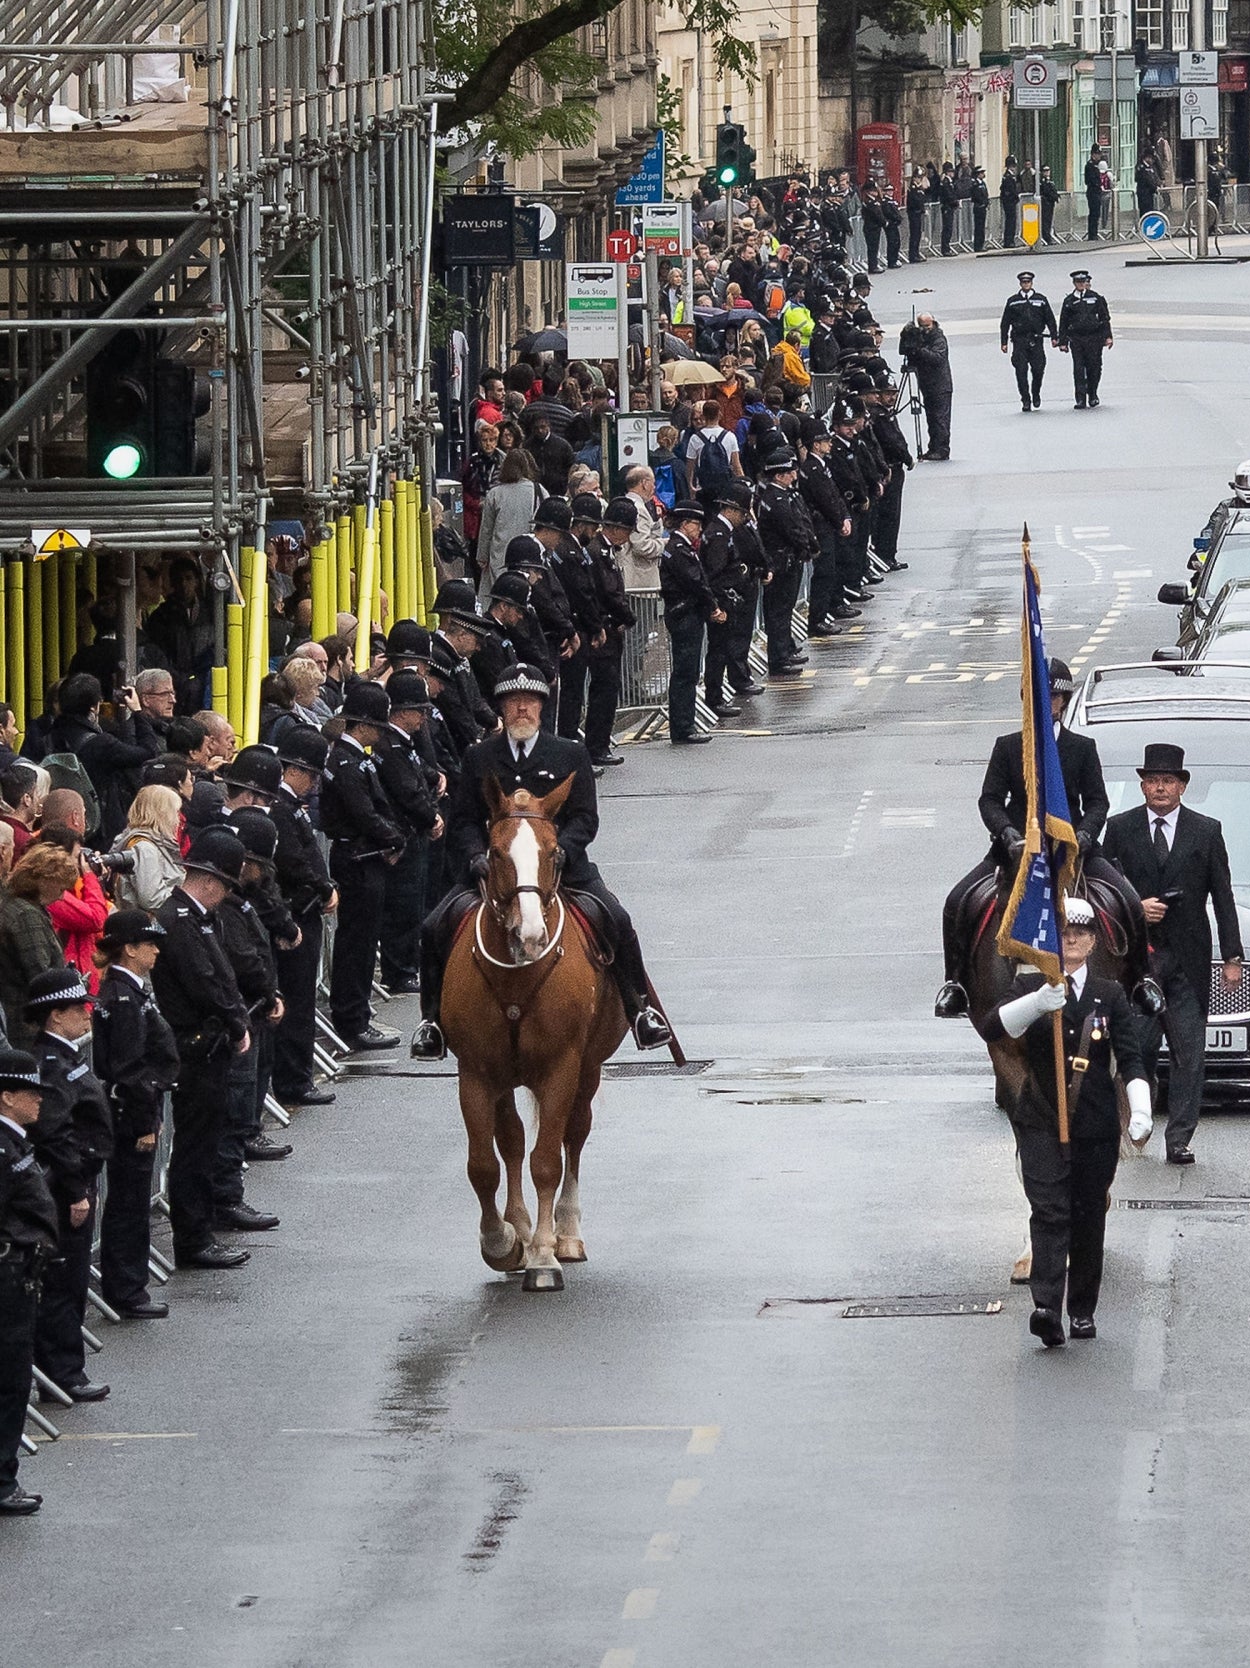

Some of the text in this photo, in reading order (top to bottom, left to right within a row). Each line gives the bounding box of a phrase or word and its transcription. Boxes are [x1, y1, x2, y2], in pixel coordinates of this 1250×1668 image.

[634, 184, 656, 193] yards
[625, 193, 648, 201] ahead
[455, 220, 503, 228] TAYLORS
[610, 238, 631, 254] T1
[592, 288, 608, 296] Stop
[1207, 1030, 1233, 1048] JD
